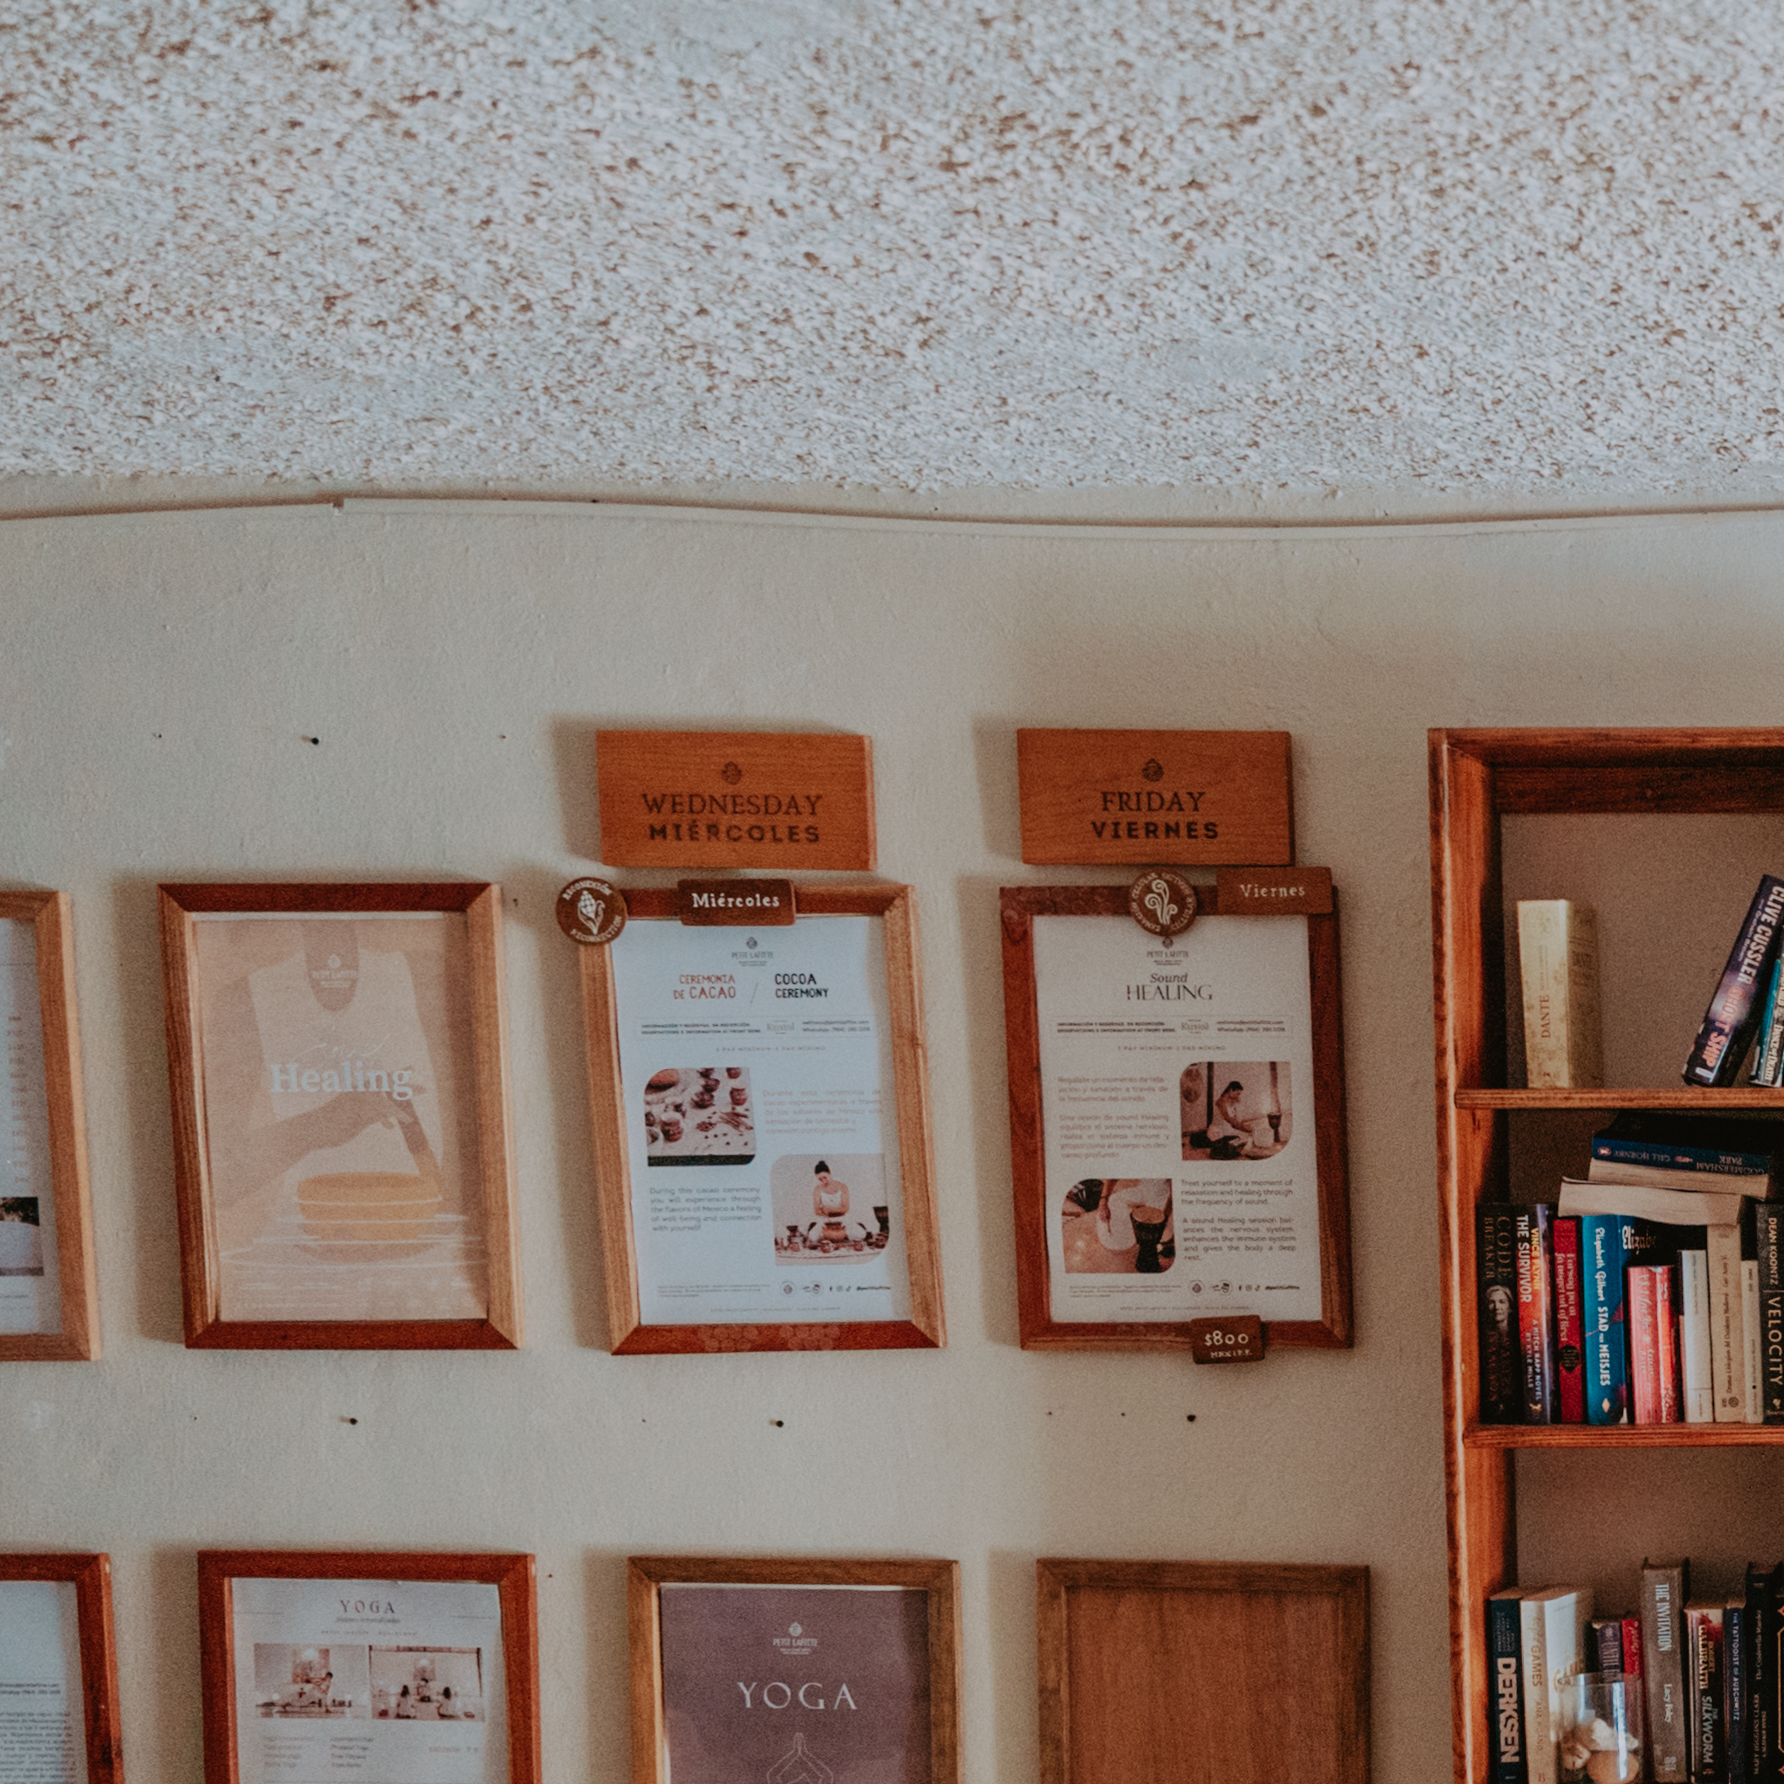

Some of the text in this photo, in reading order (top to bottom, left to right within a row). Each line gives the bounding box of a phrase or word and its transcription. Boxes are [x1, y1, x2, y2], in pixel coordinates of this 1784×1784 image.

[641, 793, 823, 816] WEDNESDAY
[1101, 791, 1206, 812] FRIDAY
[649, 820, 820, 843] MIÉRCOLES
[1091, 821, 1219, 839] VIERNES
[691, 892, 780, 908] Miércoles
[1239, 884, 1306, 898] Viernes
[1737, 924, 1773, 985] CUSSLER
[689, 986, 736, 999] CACAO
[774, 973, 817, 985] COCOA
[1127, 985, 1213, 1000] HEALING
[1150, 973, 1188, 983] Sound
[775, 988, 829, 999] CEREMONY
[1540, 994, 1551, 1039] DANTE
[1702, 985, 1745, 1067] GHOST SHIP
[269, 1061, 414, 1101] Healing
[1497, 1216, 1512, 1278] CODE
[1530, 1227, 1540, 1256] VINCE
[1768, 1217, 1779, 1285] DEAN KOONTZ
[1515, 1215, 1532, 1303] THE SURVIVOR
[1595, 1271, 1607, 1302] Gilbert
[1204, 1329, 1249, 1347] $800
[1598, 1307, 1611, 1386] STAD MEISJES
[1767, 1296, 1783, 1386] VELOCITY
[340, 1599, 396, 1615] YOGA
[1655, 1583, 1673, 1652] THE INVITATION
[1530, 1646, 1543, 1688] GAMES
[1698, 1625, 1708, 1690] GALBRAITH
[737, 1682, 858, 1710] YOGA
[1663, 1684, 1673, 1703] Lucy
[1496, 1656, 1520, 1764] DERKSEN
[1702, 1696, 1714, 1764] SILKWORM
